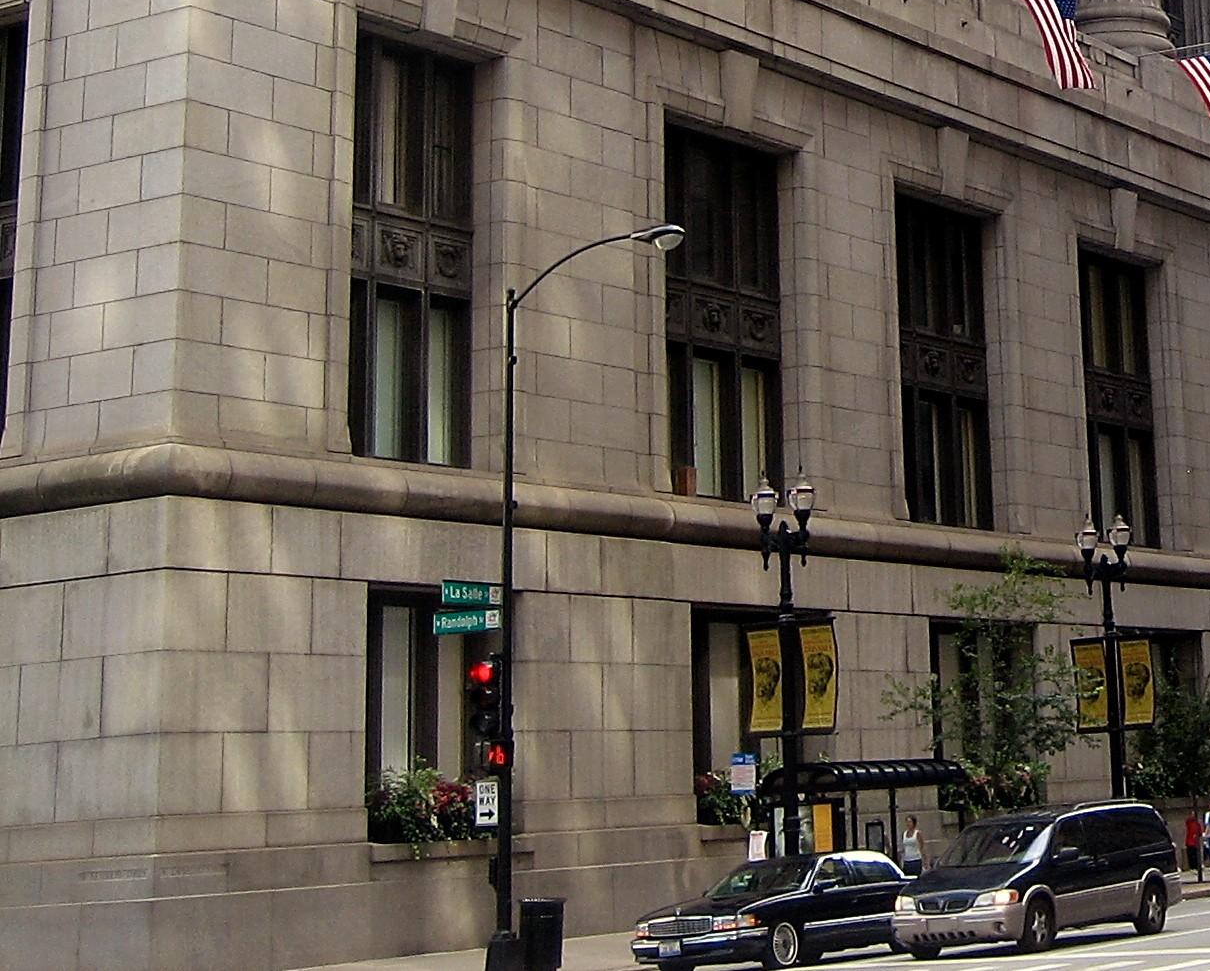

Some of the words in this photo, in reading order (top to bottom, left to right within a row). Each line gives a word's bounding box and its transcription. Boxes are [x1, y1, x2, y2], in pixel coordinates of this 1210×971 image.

[449, 585, 461, 599] La
[461, 586, 483, 601] Salle
[441, 615, 478, 630] Randolph
[479, 783, 496, 795] ONE
[479, 796, 496, 806] WAY
